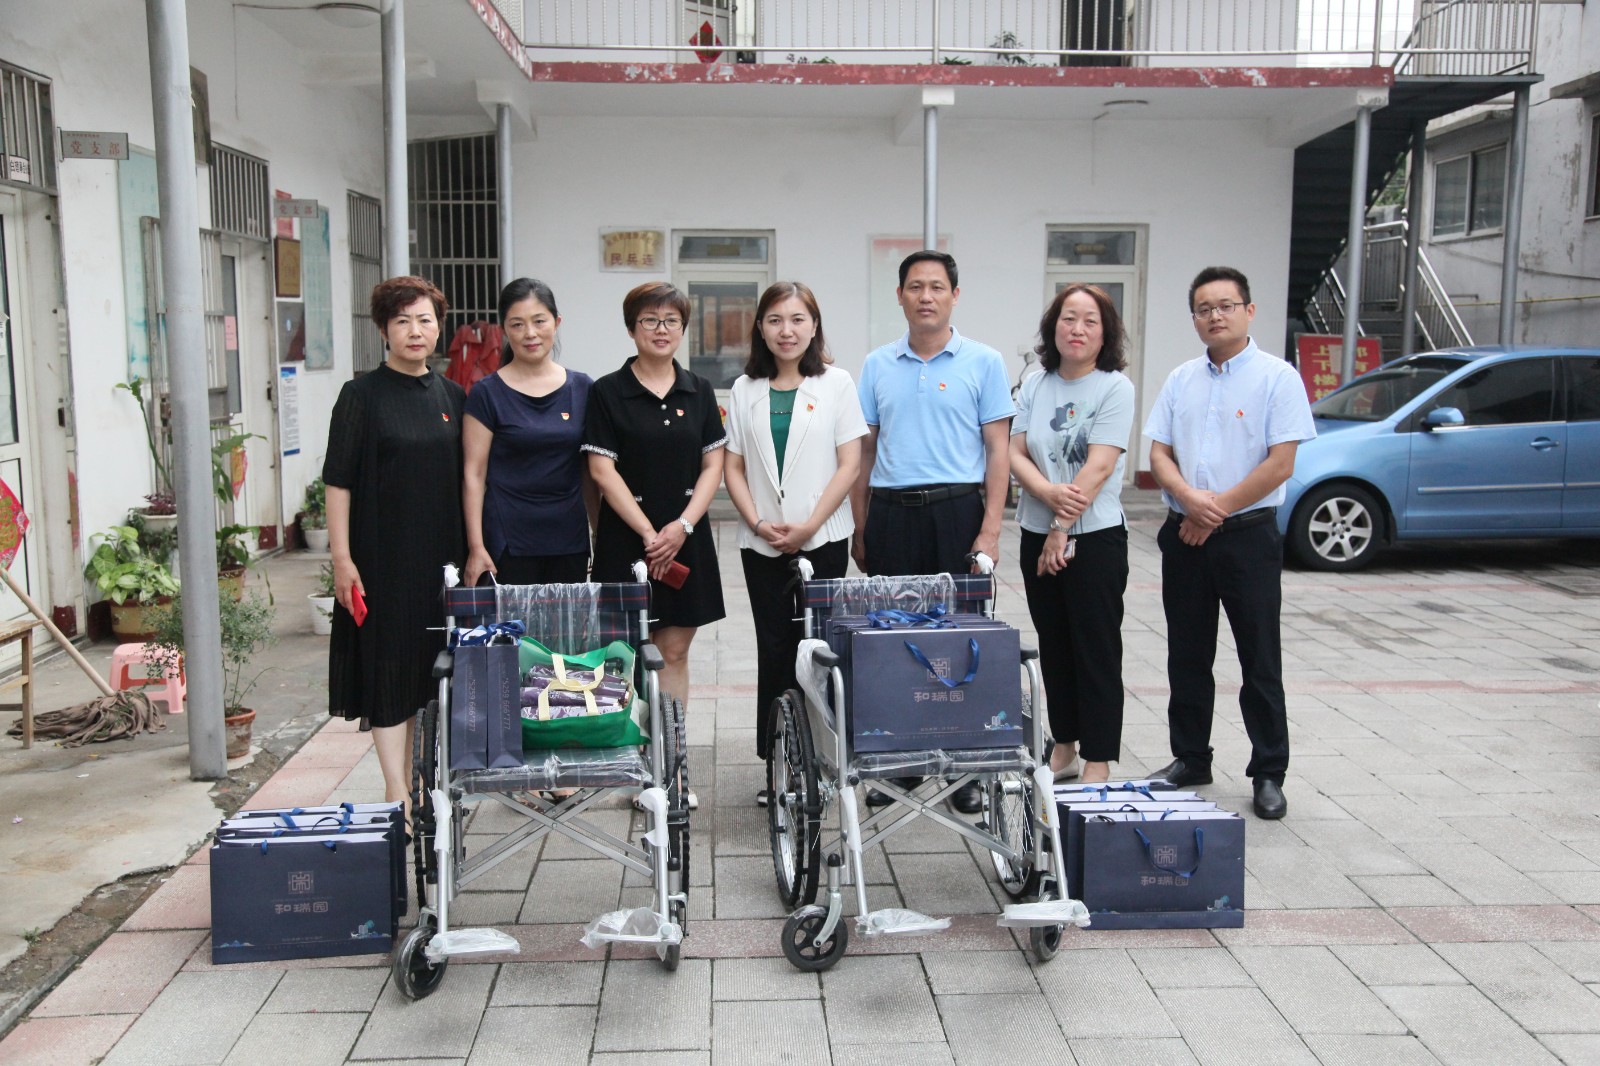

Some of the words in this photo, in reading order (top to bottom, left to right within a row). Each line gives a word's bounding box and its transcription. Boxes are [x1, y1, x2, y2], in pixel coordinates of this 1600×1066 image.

[70, 139, 121, 156] 党支部
[610, 252, 655, 266] 民兵连
[913, 690, 964, 702] 和瑞园
[1140, 874, 1189, 886] 和瑞园
[274, 902, 329, 914] 和瑞园
